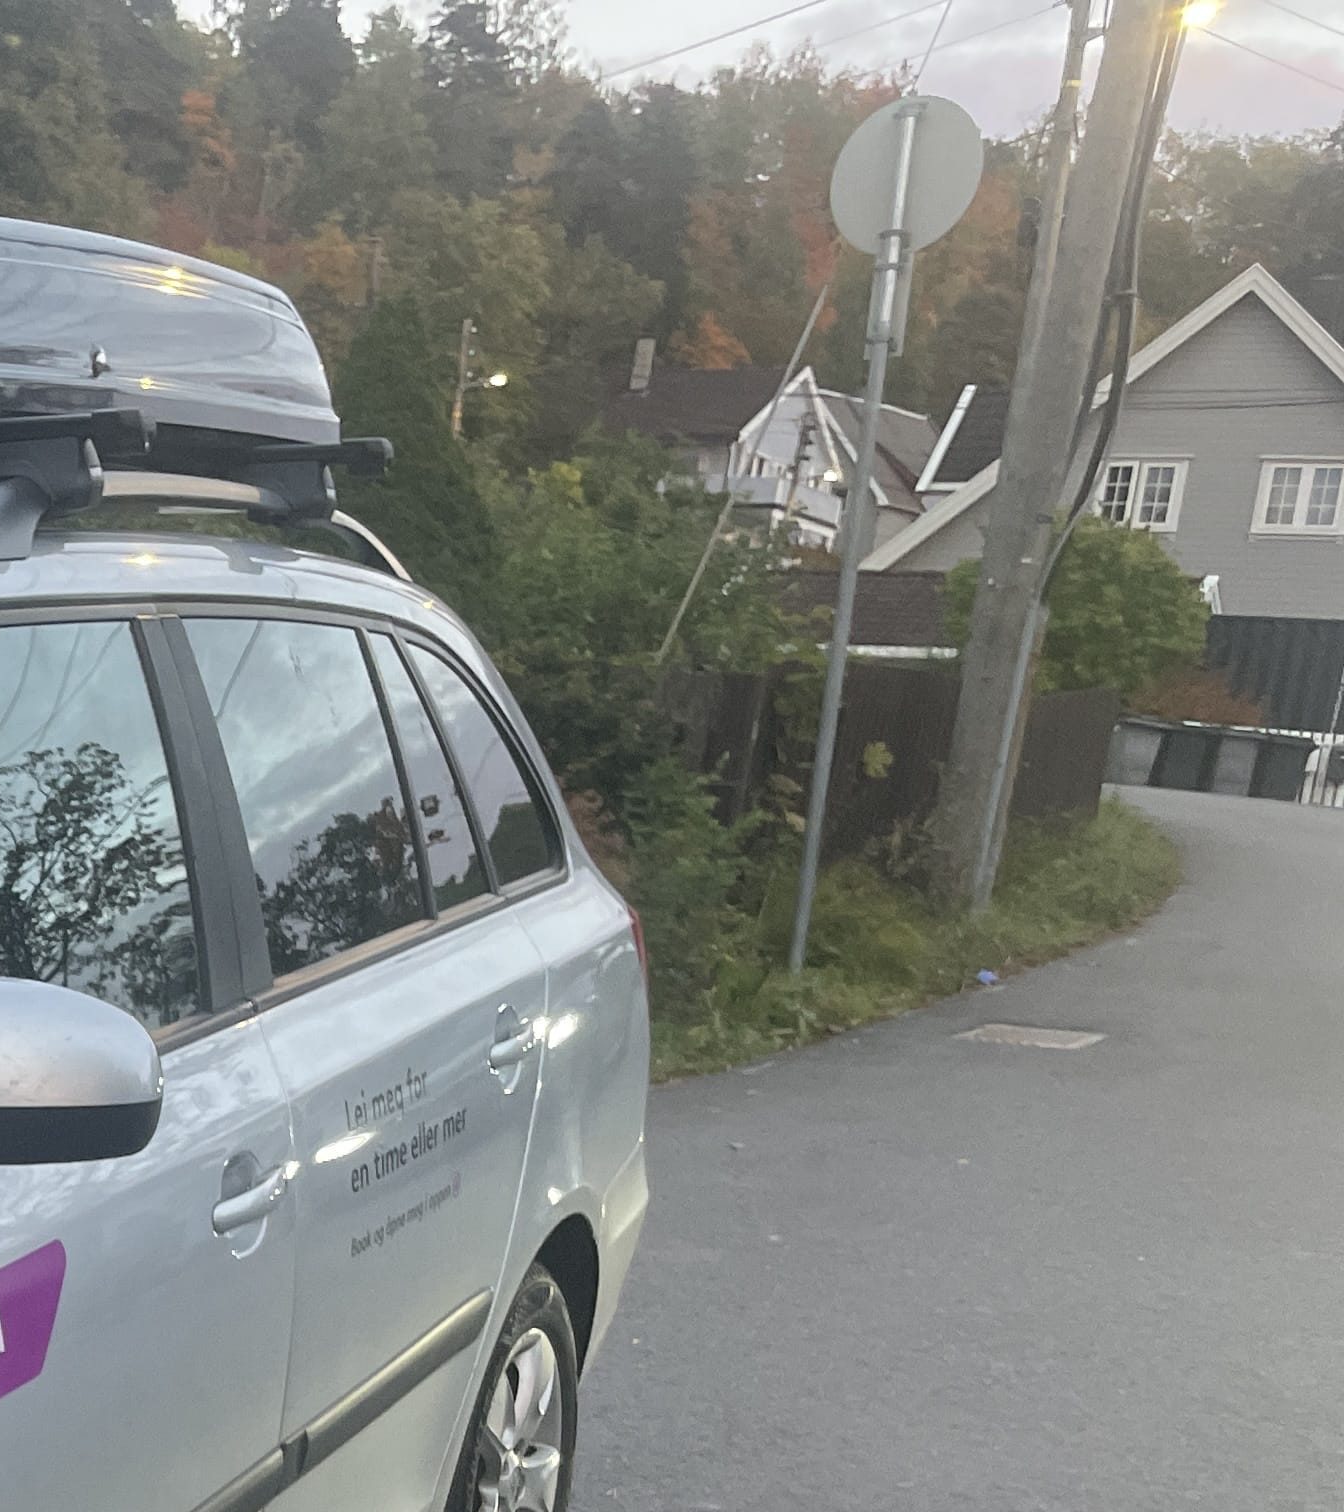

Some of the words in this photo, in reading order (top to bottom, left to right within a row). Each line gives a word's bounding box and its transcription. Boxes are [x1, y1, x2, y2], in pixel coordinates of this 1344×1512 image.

[344, 1087, 368, 1132] Lei
[406, 1066, 428, 1105] for
[351, 1162, 370, 1193] en
[373, 1141, 408, 1180] time
[411, 1120, 440, 1160] eller
[442, 1107, 467, 1142] mer
